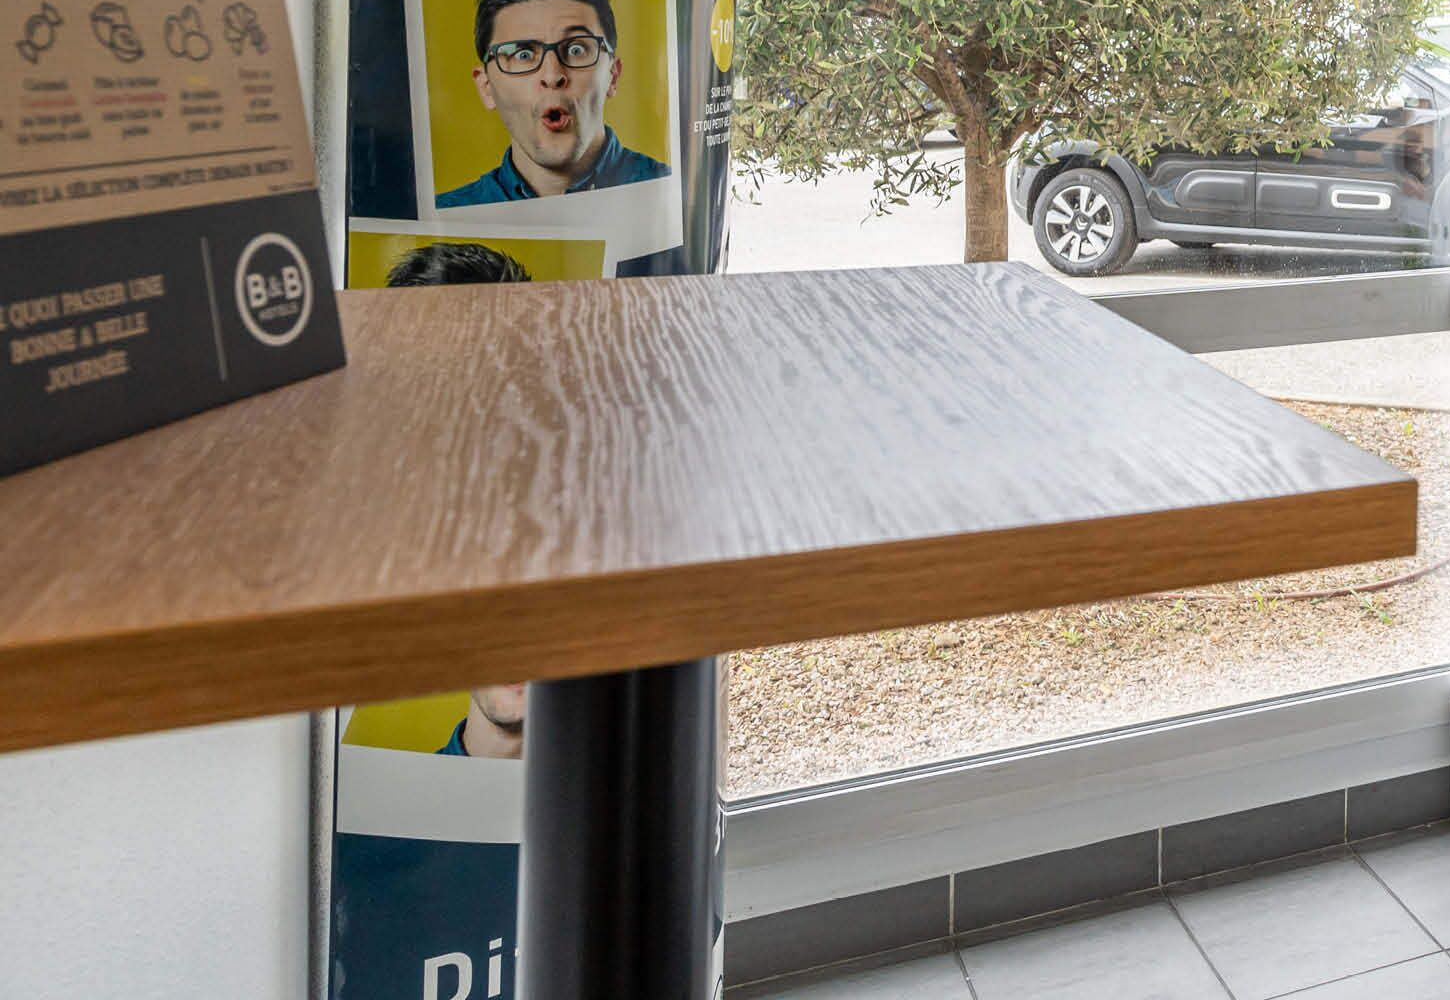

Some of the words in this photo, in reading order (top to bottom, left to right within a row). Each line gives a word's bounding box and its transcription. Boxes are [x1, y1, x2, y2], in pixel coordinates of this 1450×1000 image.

[710, 87, 721, 98] SUR
[706, 103, 714, 115] DE
[714, 102, 720, 114] LA
[694, 120, 704, 133] ET
[704, 119, 712, 132] DU
[247, 264, 303, 309] B&B
[61, 281, 126, 314] PASSER
